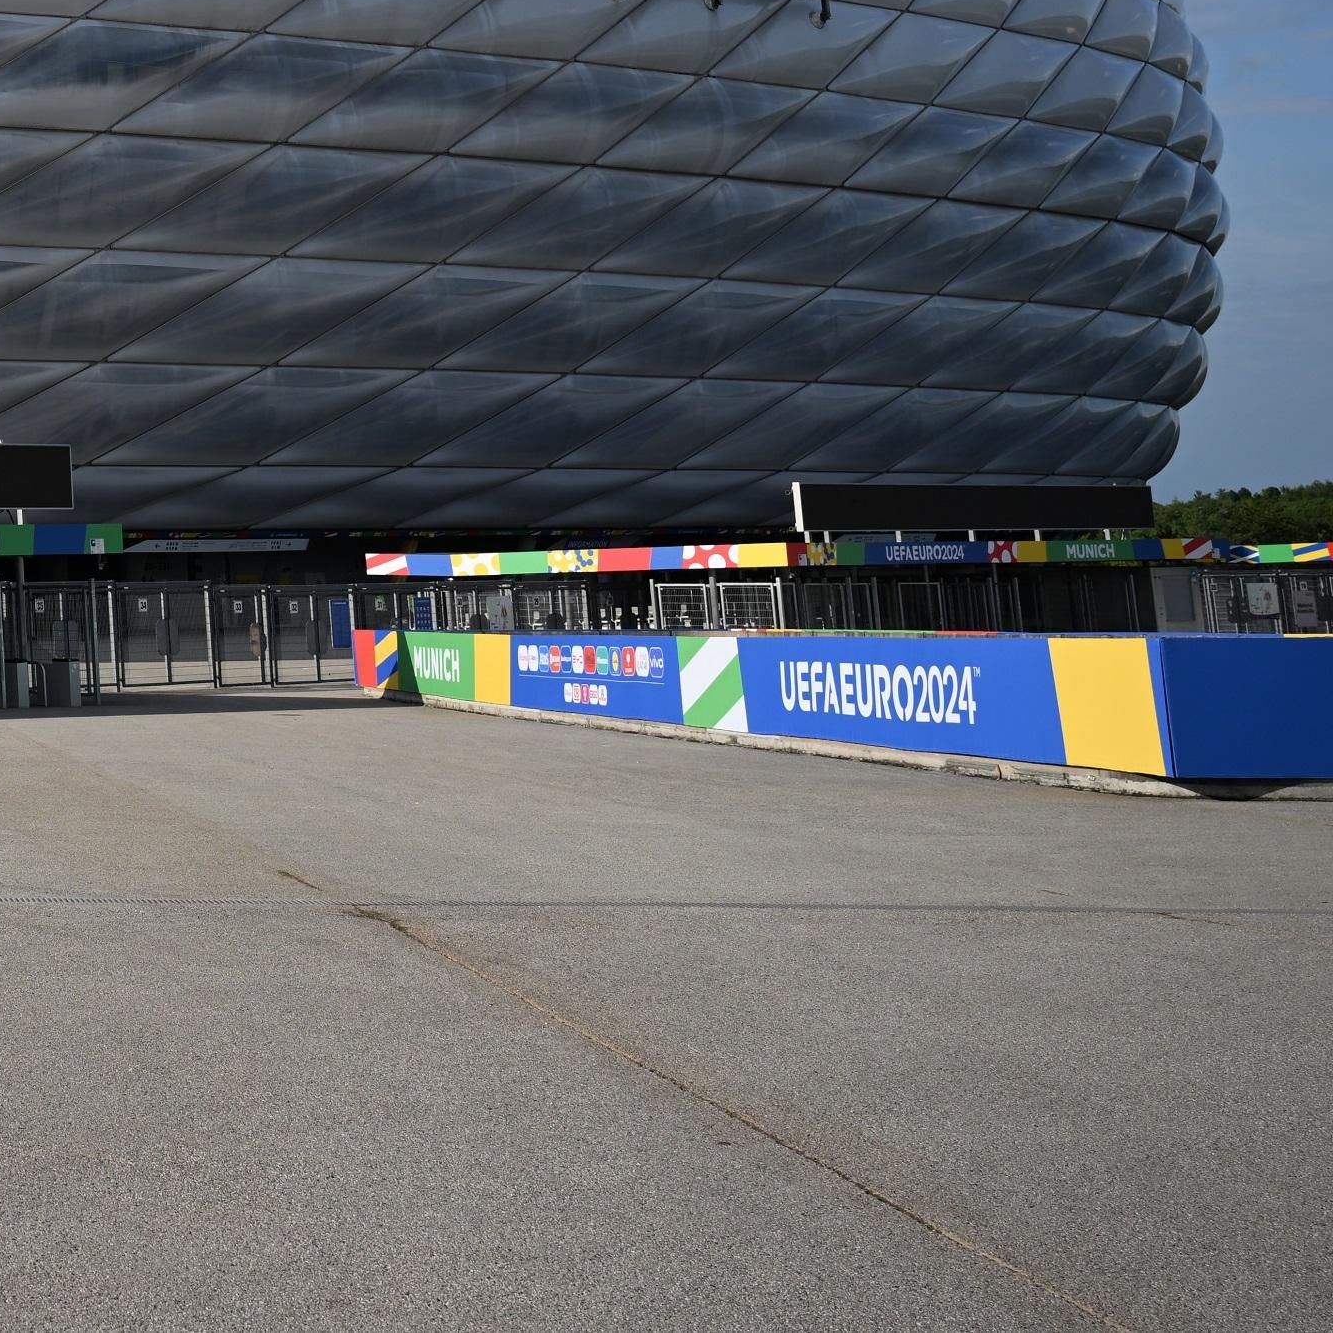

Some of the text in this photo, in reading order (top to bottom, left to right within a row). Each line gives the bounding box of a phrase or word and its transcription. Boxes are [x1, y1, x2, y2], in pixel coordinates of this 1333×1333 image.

[1065, 543, 1115, 559] MUNICH
[140, 601, 147, 610] 34
[413, 646, 460, 683] MUNICH
[649, 655, 664, 668] vivo
